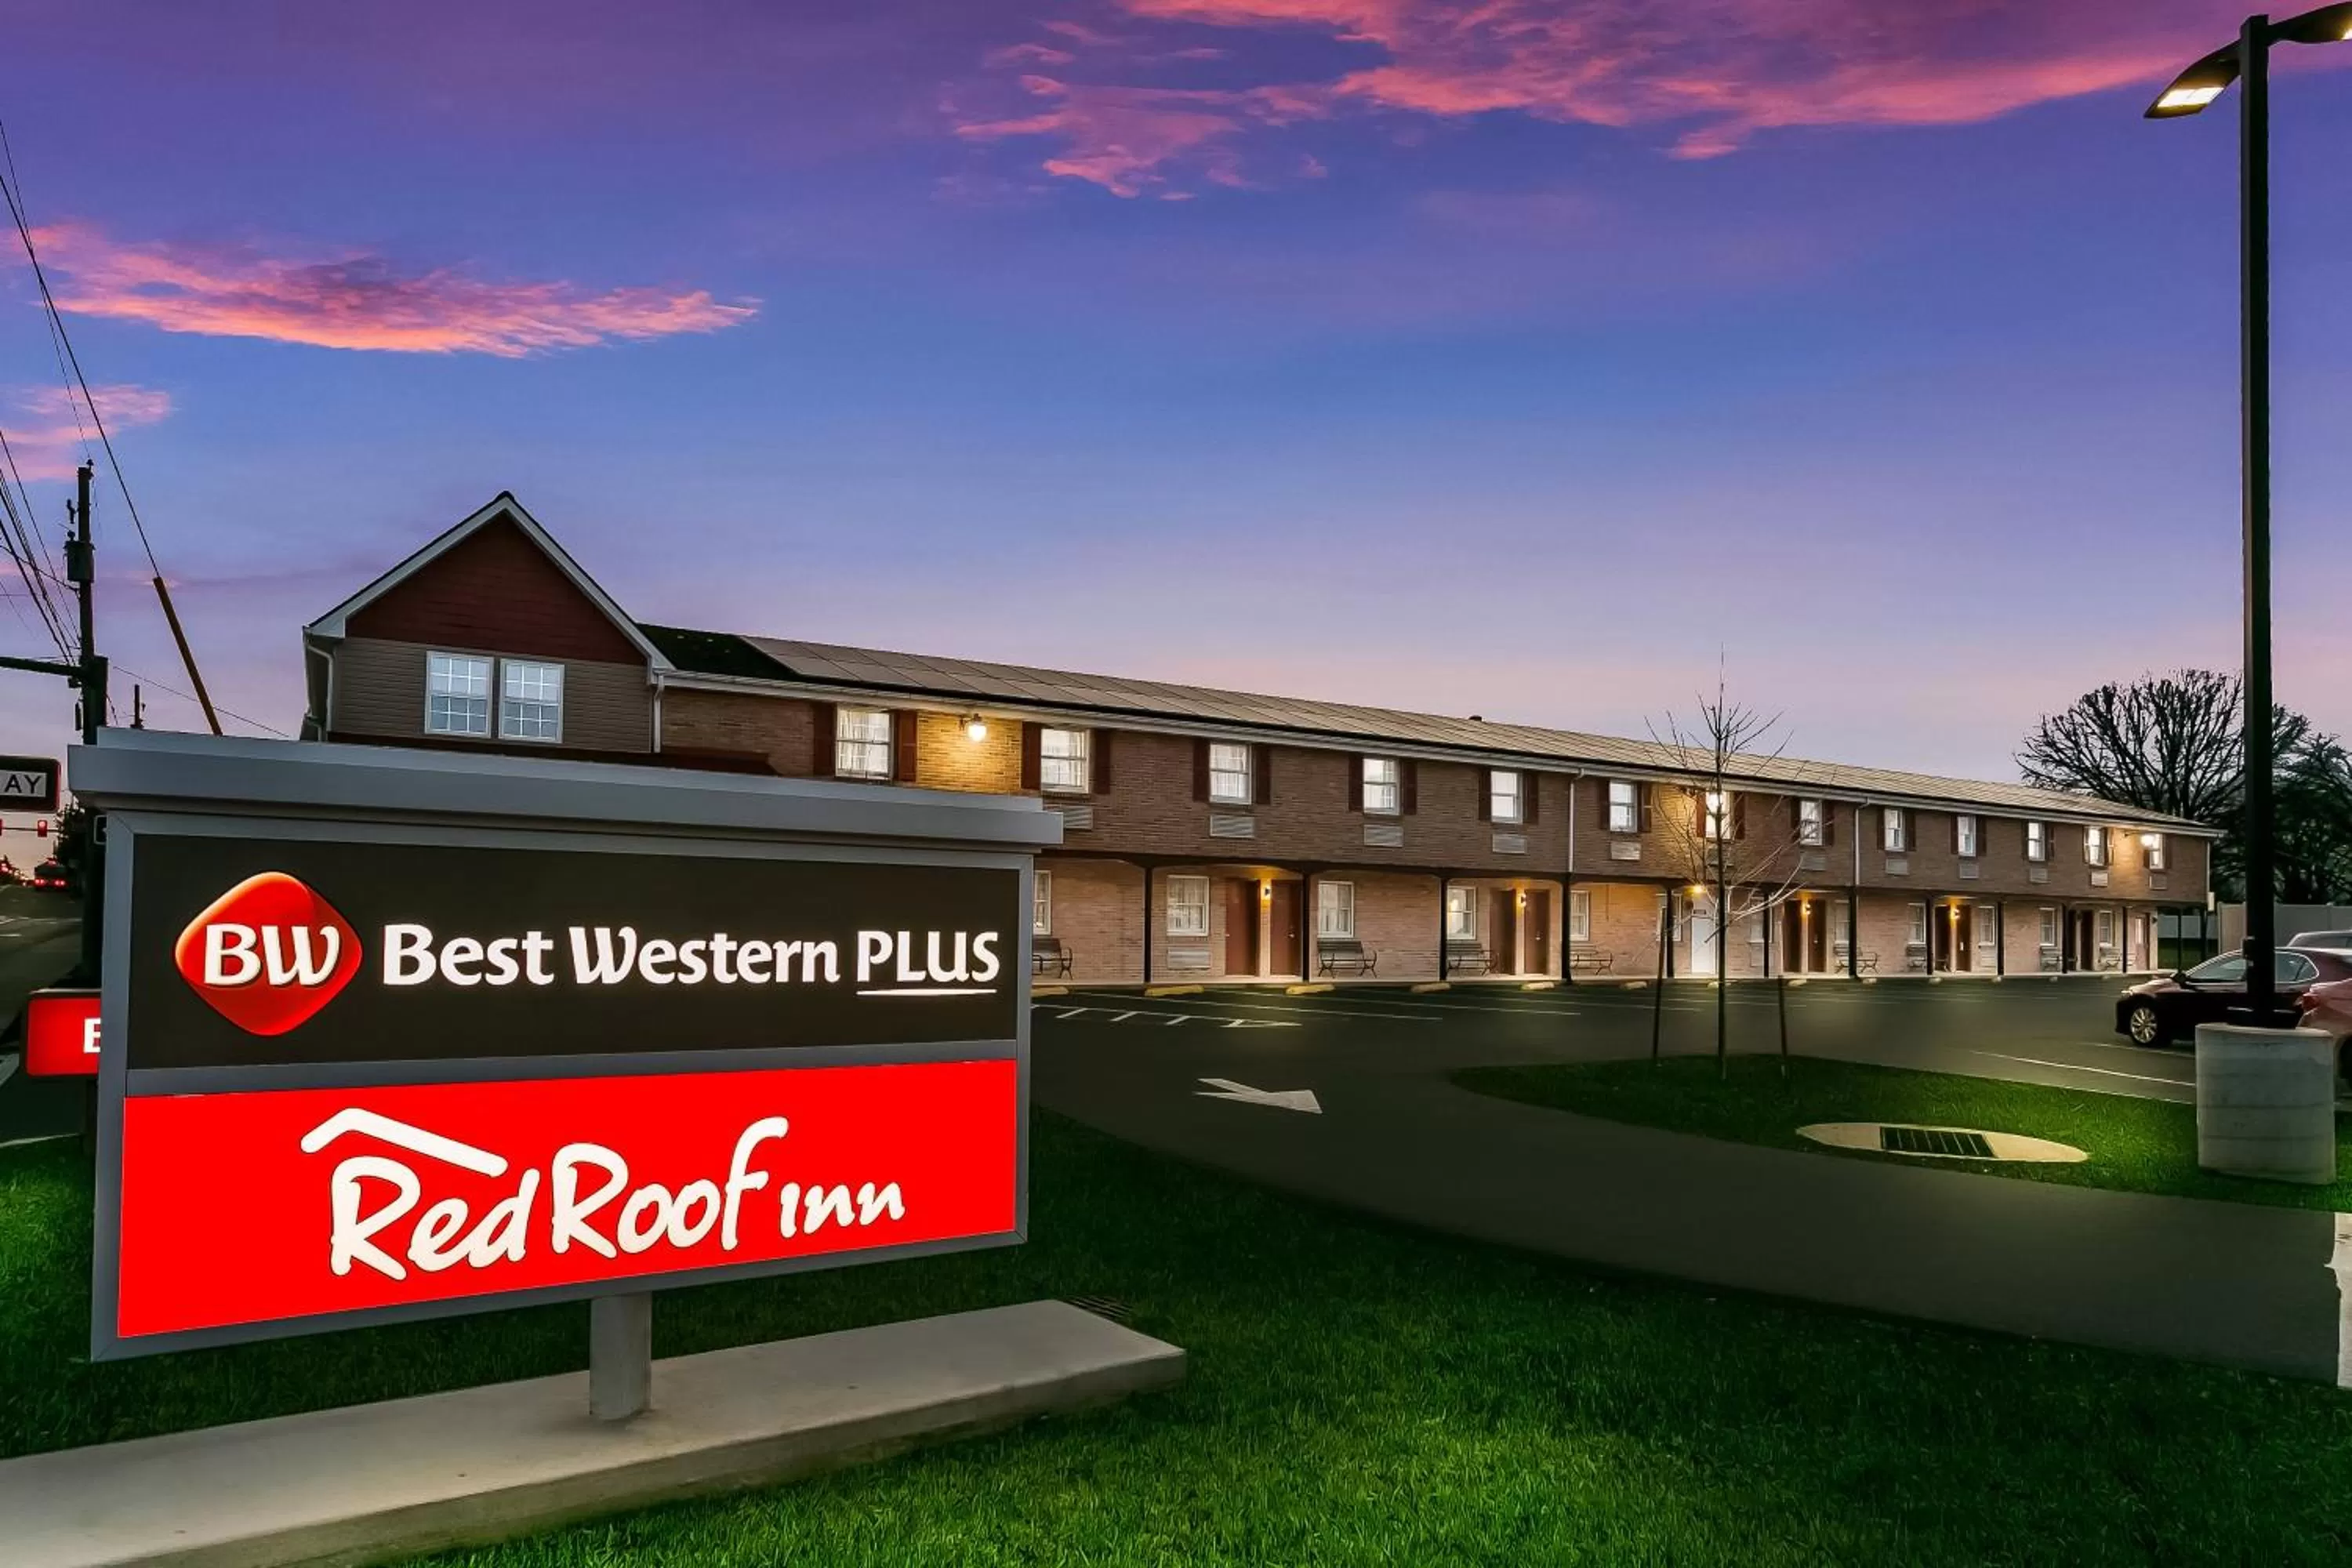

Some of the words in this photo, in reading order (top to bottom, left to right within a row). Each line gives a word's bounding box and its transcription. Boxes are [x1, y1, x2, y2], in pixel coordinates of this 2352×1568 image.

[204, 923, 340, 986] BW
[383, 923, 555, 986] Best
[568, 925, 841, 985] Western
[856, 930, 1000, 983] PLUS
[330, 1155, 541, 1281] Red
[550, 1116, 789, 1259] Roof
